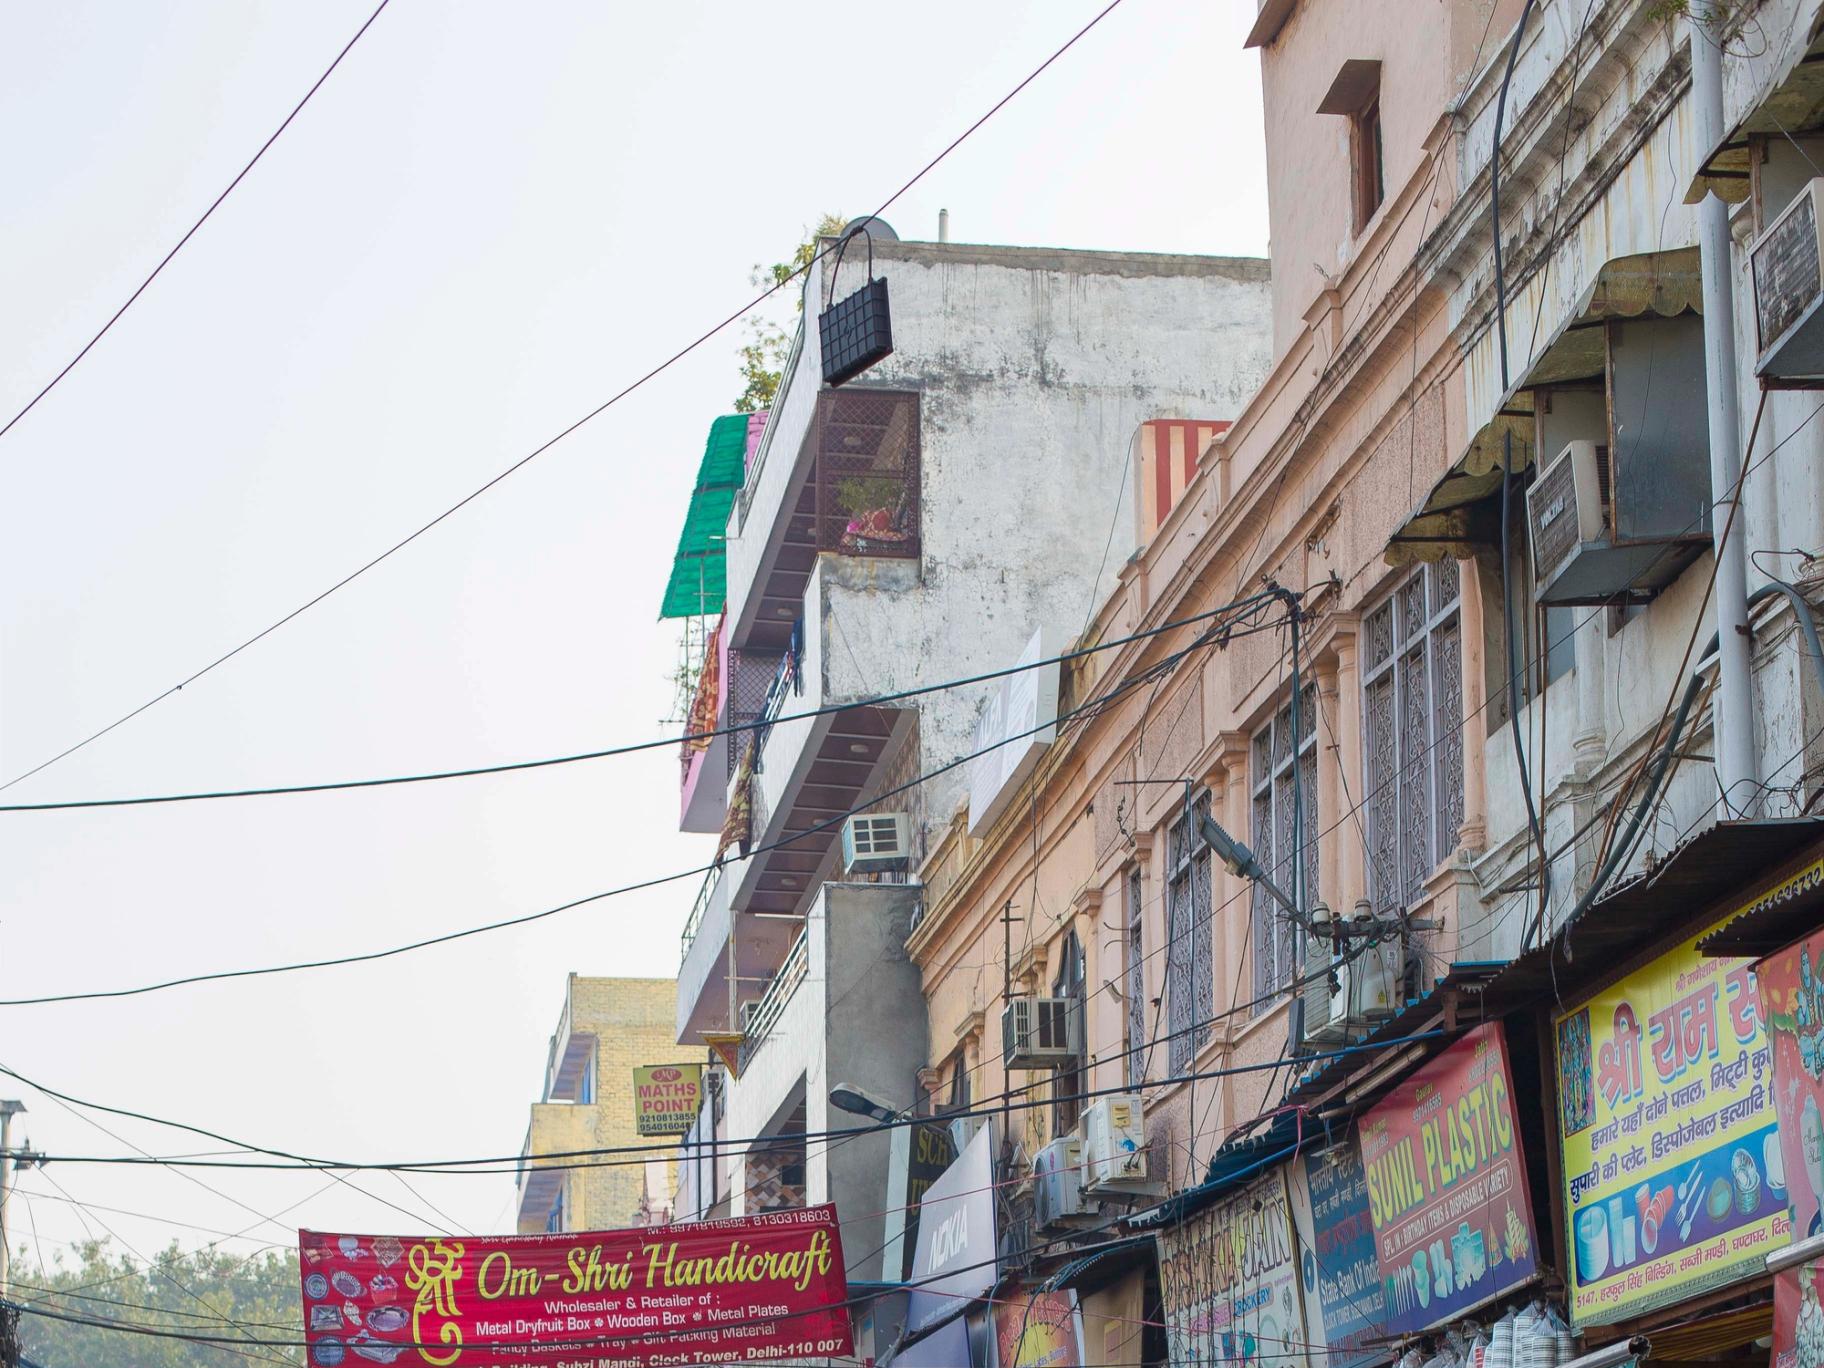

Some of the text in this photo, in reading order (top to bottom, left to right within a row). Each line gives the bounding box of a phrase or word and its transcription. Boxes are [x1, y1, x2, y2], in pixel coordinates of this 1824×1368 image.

[1598, 999, 1644, 1110] श्री
[1649, 981, 1719, 1085] राम
[639, 1082, 697, 1099] MATHS
[642, 1099, 695, 1114] POINT
[1591, 1117, 1620, 1151] हमारे
[1645, 1090, 1668, 1120] दोने
[1366, 1072, 1513, 1230] SUNIL PLASTIC
[1570, 1161, 1600, 1205] सुपारी
[1602, 1152, 1618, 1182] की
[753, 1209, 831, 1226] 8130318603
[1403, 1217, 1429, 1246] BIRTHDAY
[1428, 1206, 1444, 1231] ITEMS
[1449, 1181, 1485, 1217] DISPOSABLE
[1483, 1166, 1509, 1198] VARIETY
[928, 1204, 968, 1275] NOKIA
[478, 1229, 833, 1300] Om-Shri Handicraft
[1321, 1275, 1339, 1305] State
[1338, 1268, 1355, 1296] Bank
[1355, 1264, 1364, 1290] Of
[476, 1304, 789, 1336] Metal Dryfruit Box Wooden Box Metal Plates
[544, 1298, 621, 1314] Wholesaler
[626, 1297, 637, 1309] &
[641, 1294, 694, 1309] Retailer
[698, 1292, 712, 1305] of
[722, 1322, 777, 1339] Material
[649, 1353, 689, 1367] Clock
[693, 1350, 743, 1363] Tower,
[746, 1341, 814, 1359] Delhi-110
[817, 1338, 844, 1353] 007
